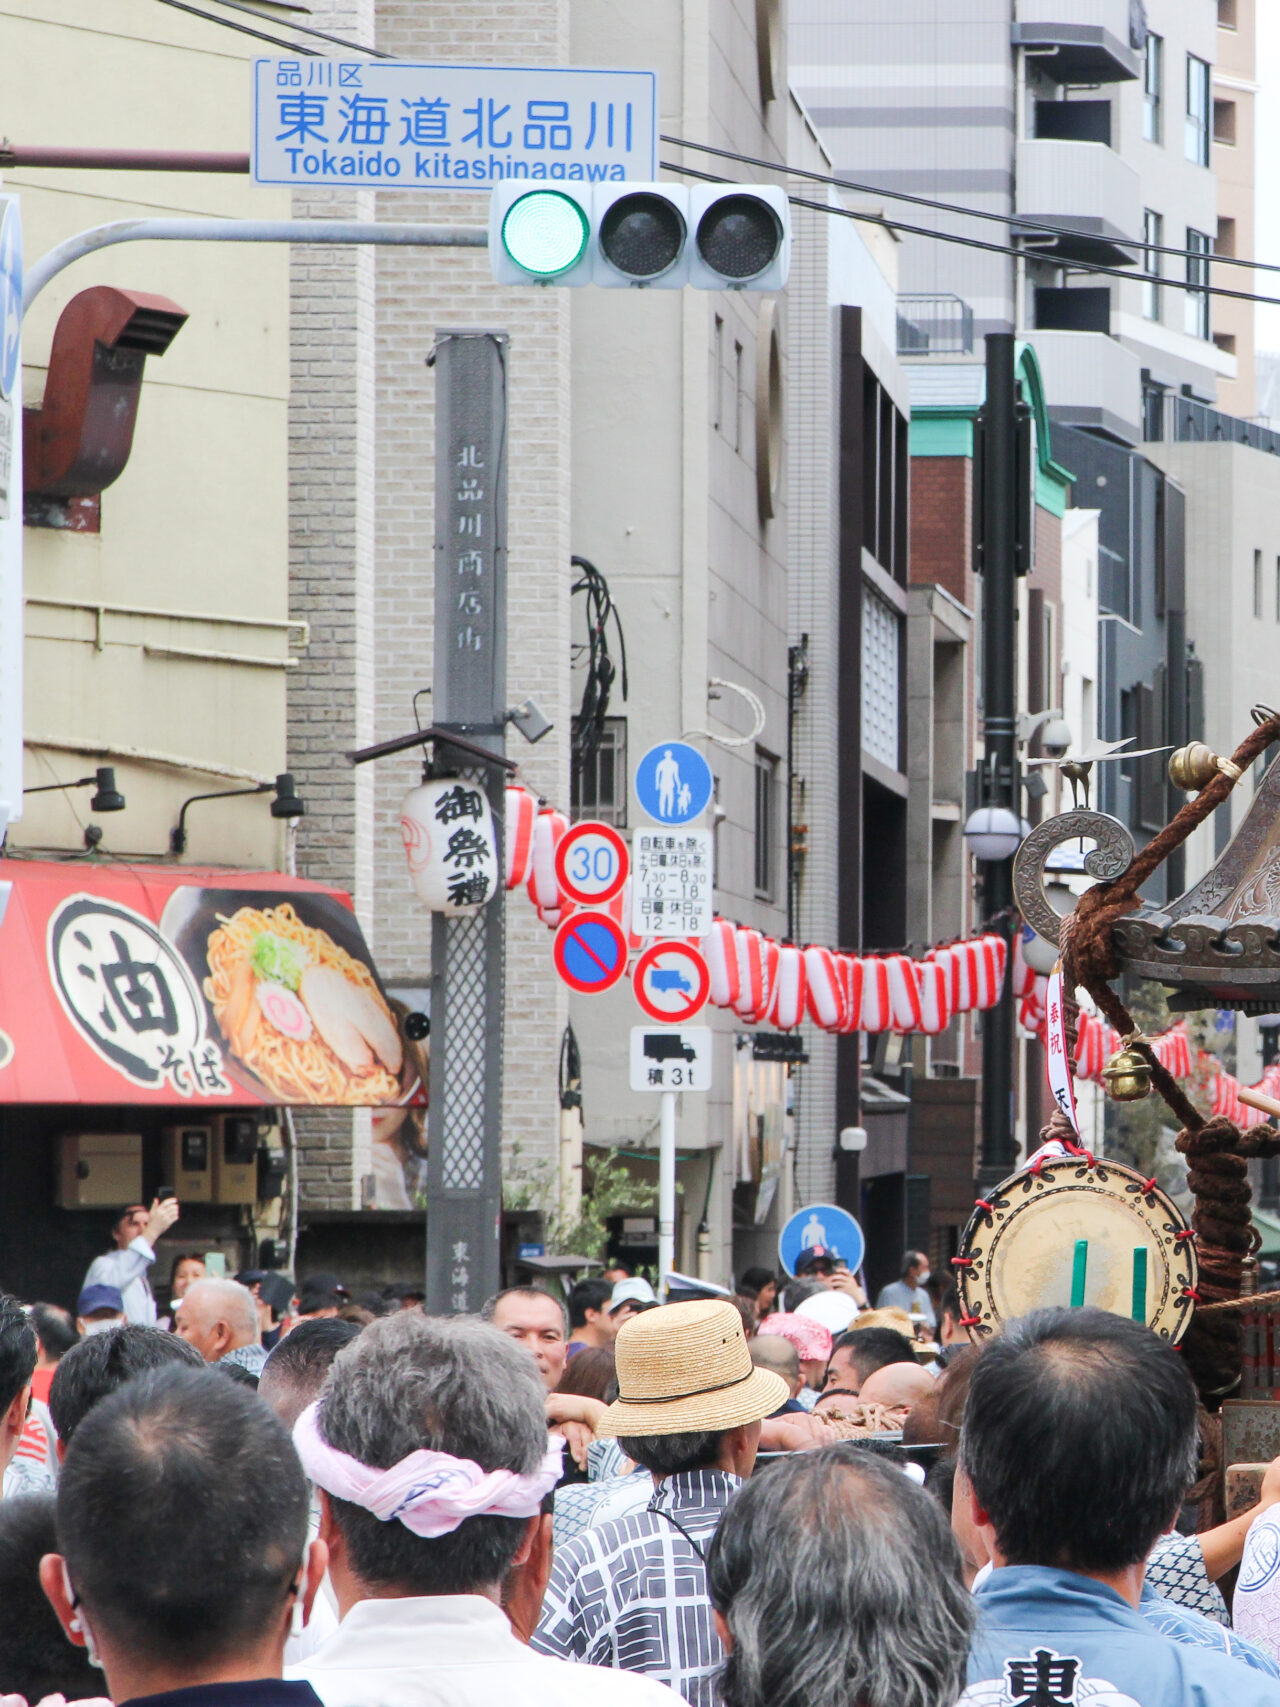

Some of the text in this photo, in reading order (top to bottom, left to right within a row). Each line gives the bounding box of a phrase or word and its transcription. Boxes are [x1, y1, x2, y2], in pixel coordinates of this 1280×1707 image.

[275, 61, 364, 88] 品川区
[275, 91, 633, 152] 東海道北品川
[284, 147, 626, 181] Tokaido kitashinagawa
[641, 836, 705, 851] 自転車を除く
[571, 846, 613, 882] 30
[74, 930, 179, 1036] 油
[157, 1045, 227, 1091] そば
